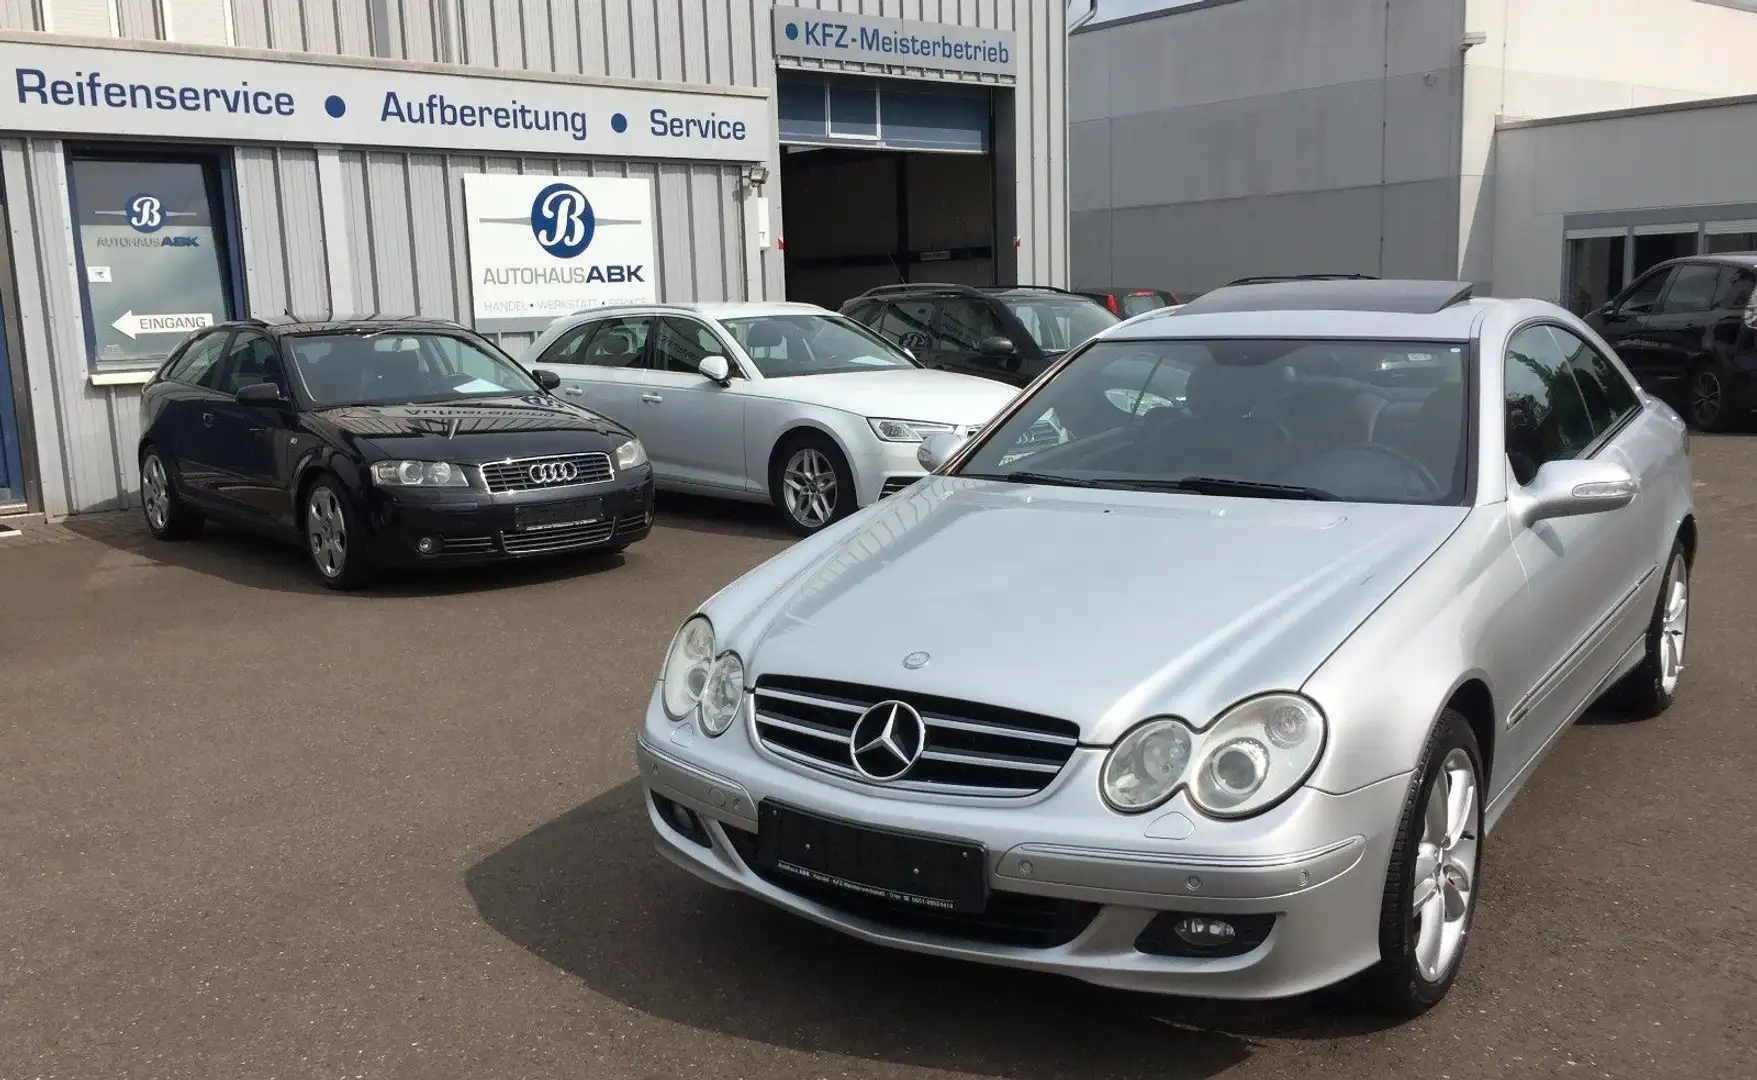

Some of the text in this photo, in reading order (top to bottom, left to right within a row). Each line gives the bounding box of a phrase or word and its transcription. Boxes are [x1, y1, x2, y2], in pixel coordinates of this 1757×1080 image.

[805, 21, 1010, 64] KFZ-Meisterbetrieb
[15, 67, 746, 141] Reifenservice Aufbereitung Service
[483, 301, 528, 312] HANDEL
[537, 298, 597, 310] WERKSTATT
[139, 315, 206, 331] EINGANG
